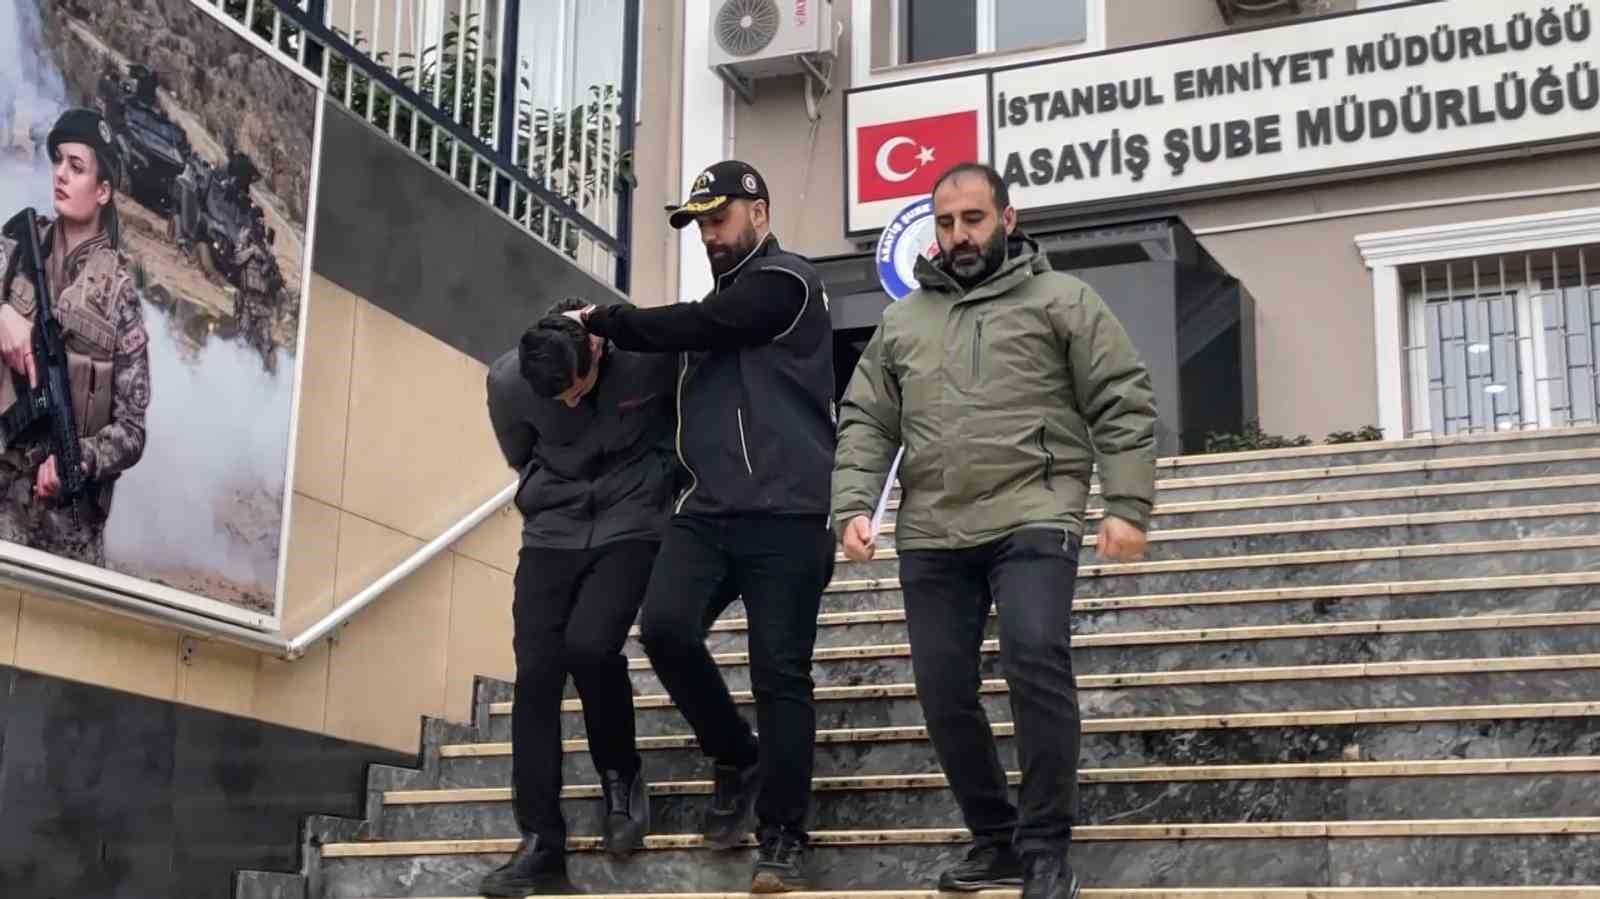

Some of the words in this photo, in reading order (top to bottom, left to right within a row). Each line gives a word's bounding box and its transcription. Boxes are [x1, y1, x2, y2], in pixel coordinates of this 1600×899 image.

[998, 77, 1164, 128] İSTANBUL
[1174, 48, 1334, 102] EMNİYET
[1346, 3, 1591, 76] MÜDÜRLÜĞÜ
[1003, 128, 1150, 187] ASAYİŞ
[1164, 114, 1282, 176] ŞUBE
[1297, 61, 1599, 150] MÜDÜRLÜĞÜ
